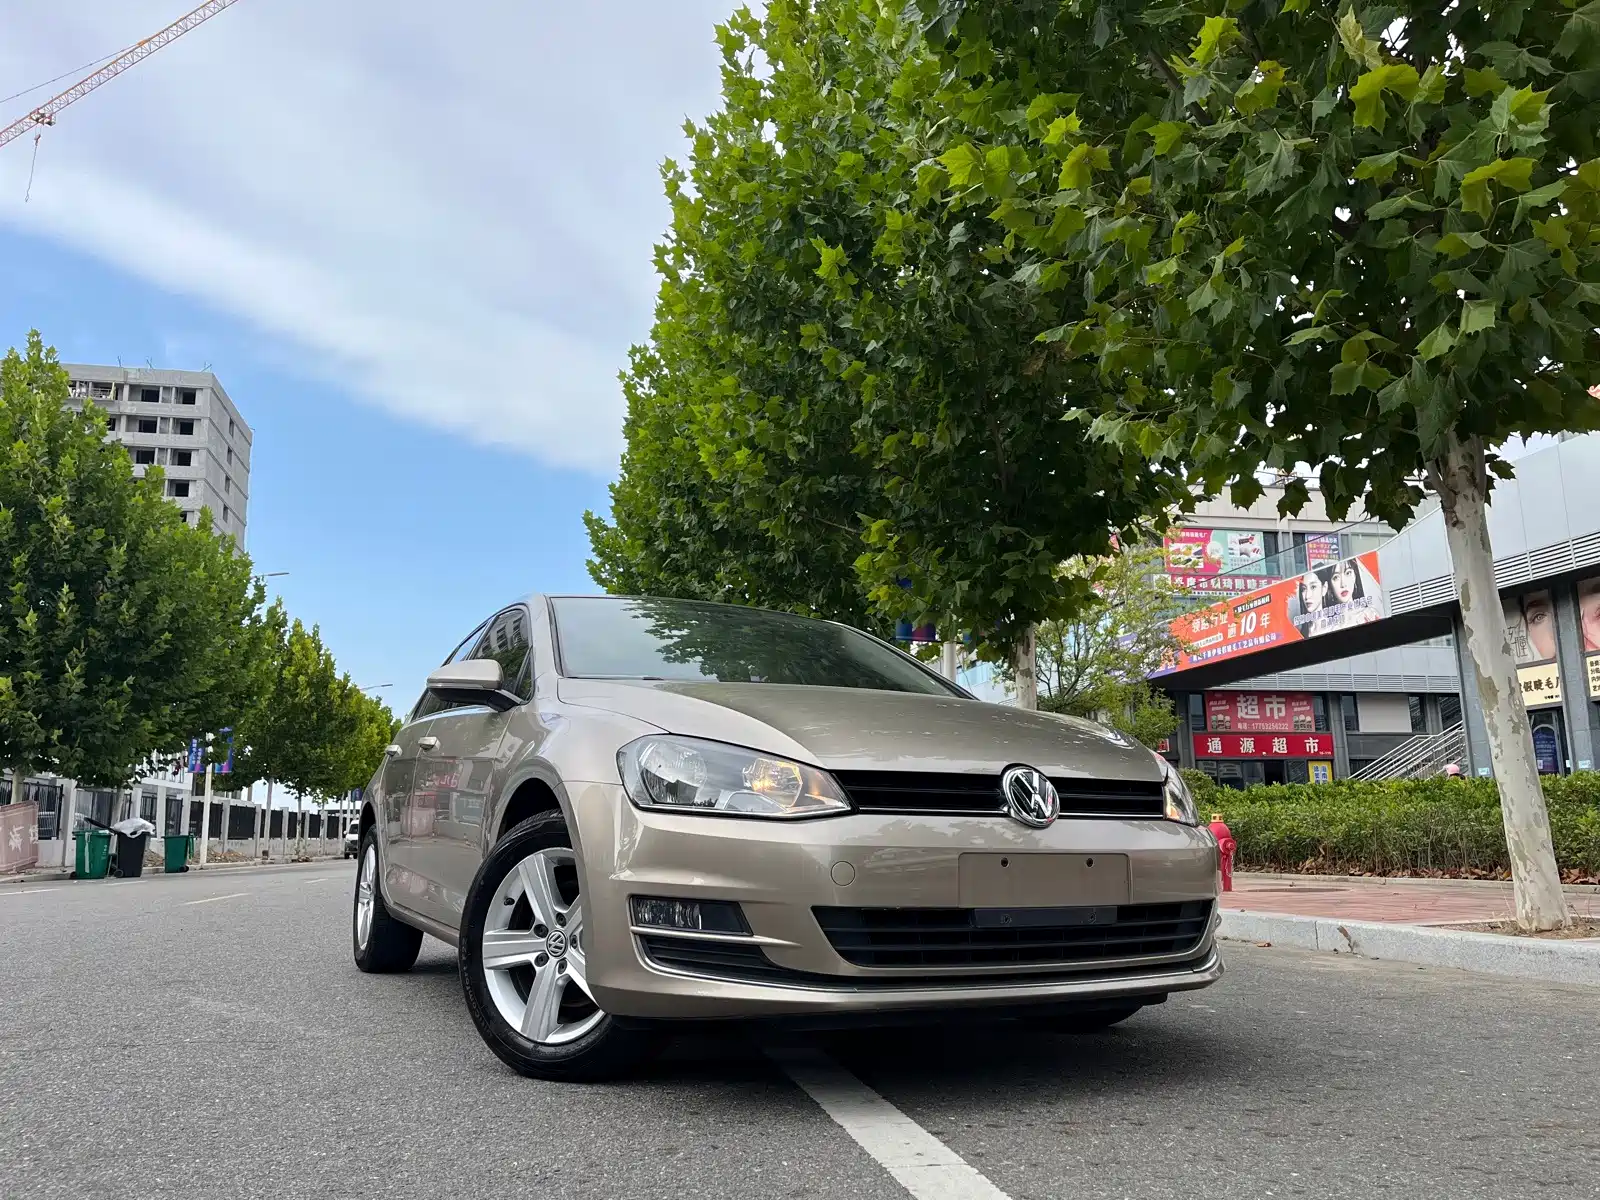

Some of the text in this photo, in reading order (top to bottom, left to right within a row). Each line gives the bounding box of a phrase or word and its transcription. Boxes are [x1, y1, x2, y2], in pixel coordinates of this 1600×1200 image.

[1521, 676, 1559, 693] 假睫毛
[1236, 694, 1286, 719] 超市
[1207, 736, 1319, 754] 通源超市
